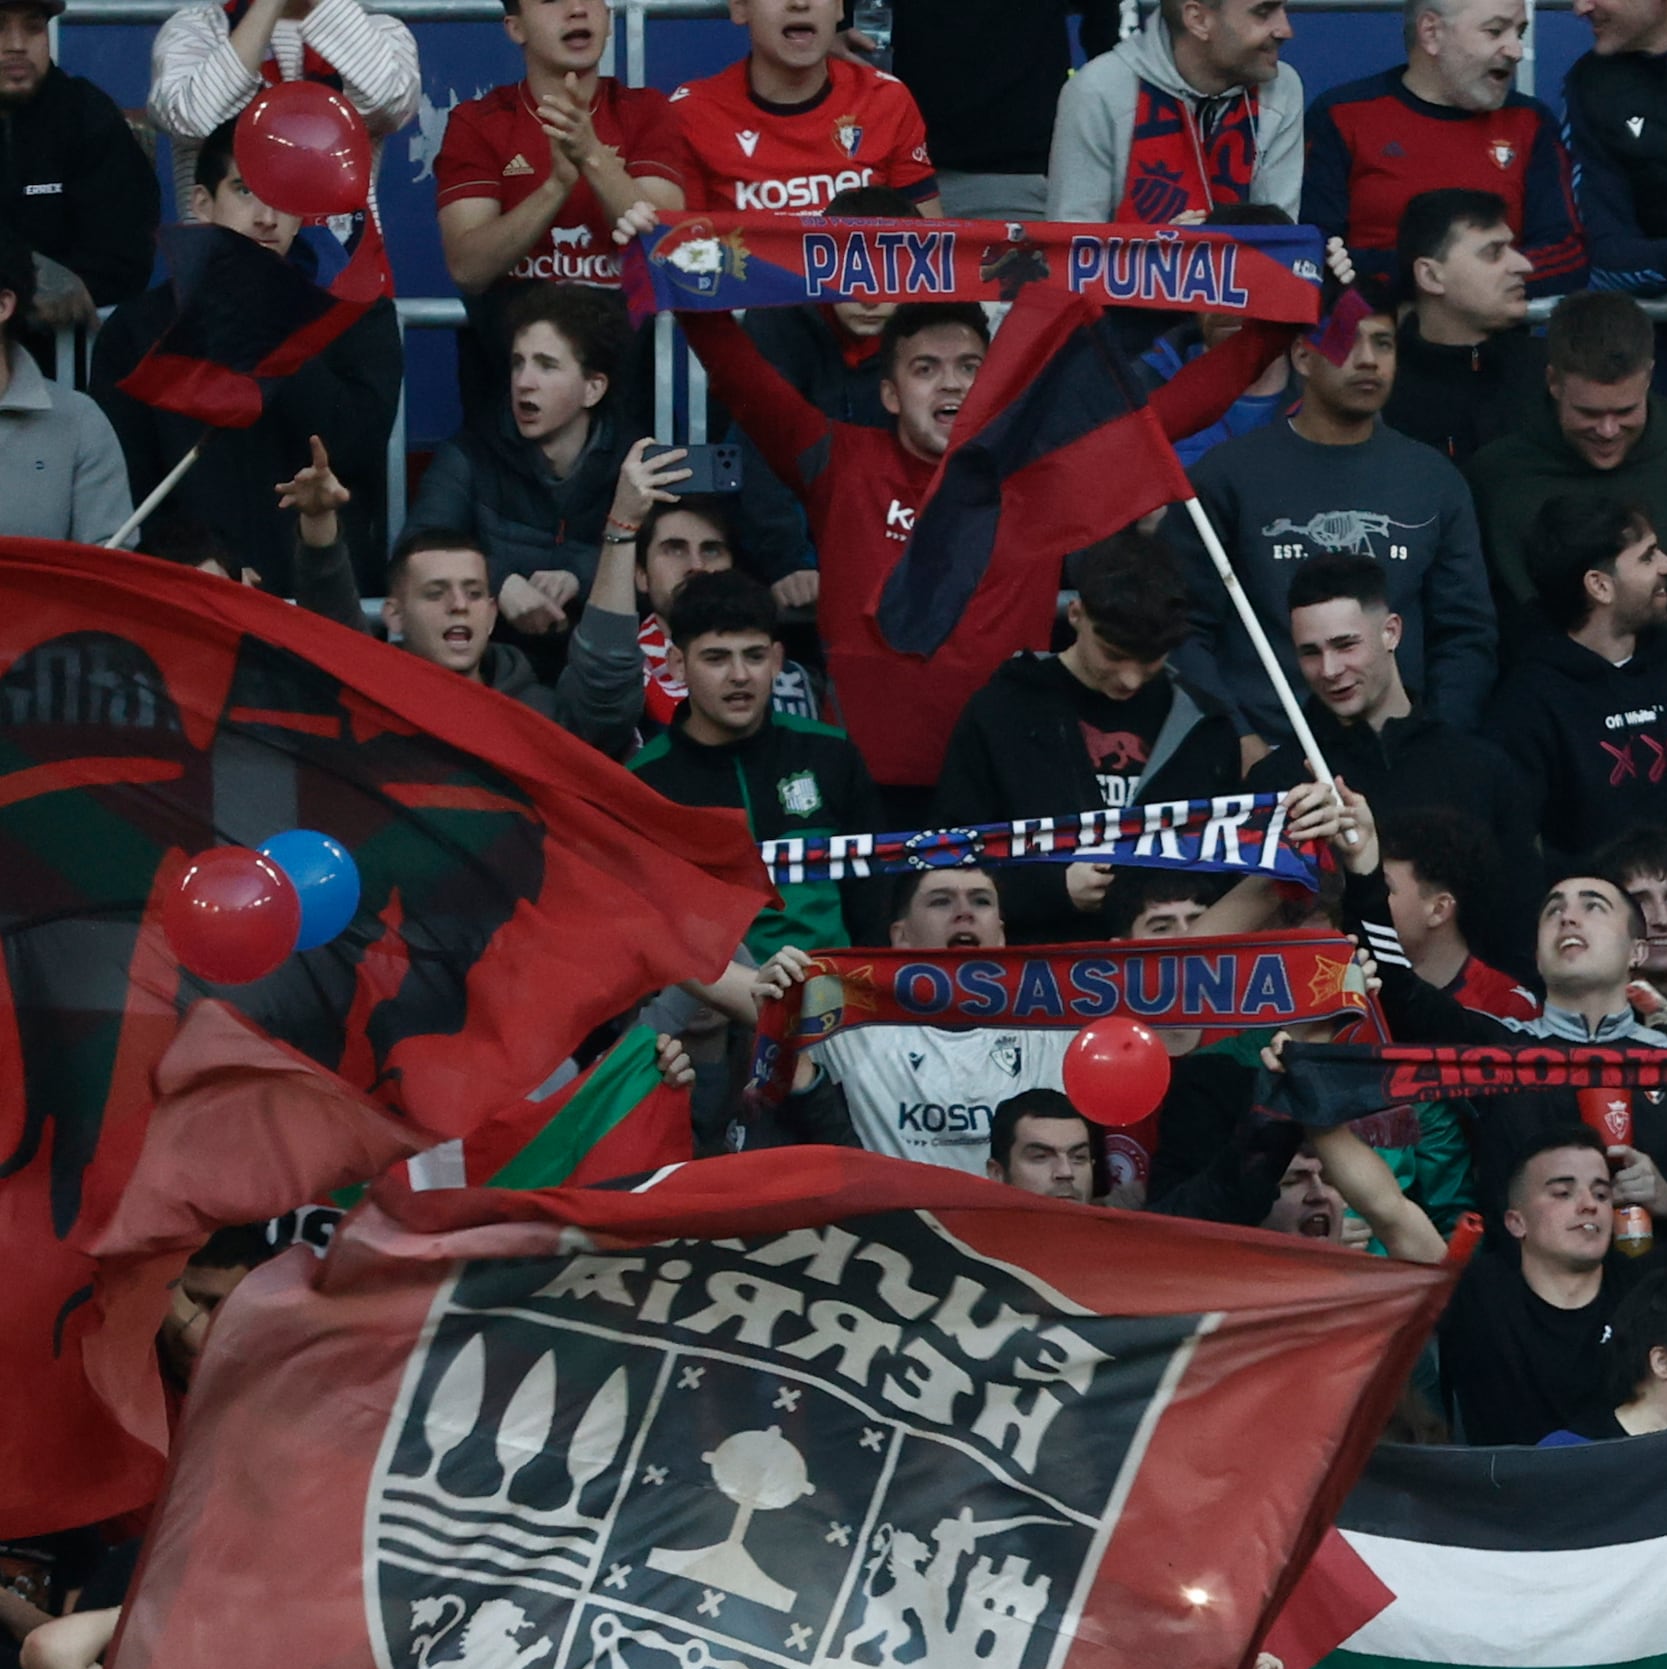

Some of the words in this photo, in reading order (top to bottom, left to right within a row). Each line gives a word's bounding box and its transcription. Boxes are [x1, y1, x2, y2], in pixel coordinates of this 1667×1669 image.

[803, 233, 955, 296] PATXI
[1069, 230, 1247, 308] PUÑAL
[893, 953, 1297, 1018] OSASUNA
